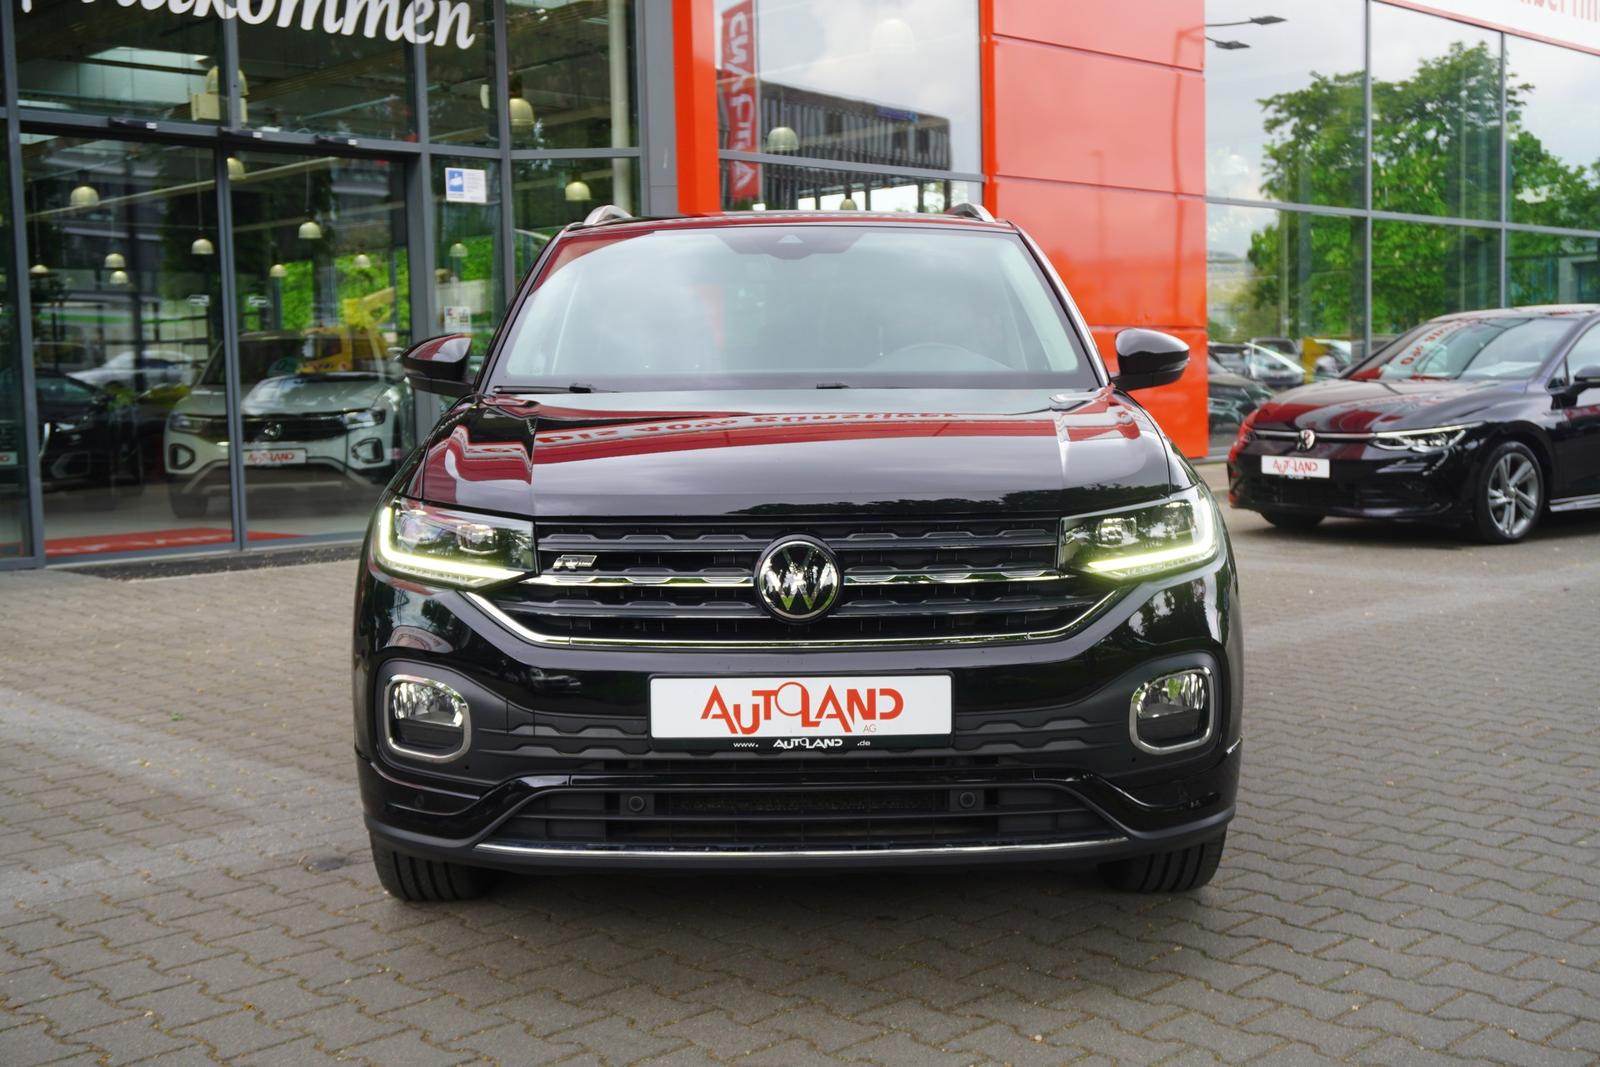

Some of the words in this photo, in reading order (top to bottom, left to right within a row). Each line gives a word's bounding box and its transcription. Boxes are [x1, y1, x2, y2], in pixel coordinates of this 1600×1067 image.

[81, 0, 476, 50] ommen
[700, 681, 904, 735] AUTOLAND
[773, 737, 843, 750] AUTOLAND
[862, 724, 877, 734] AG
